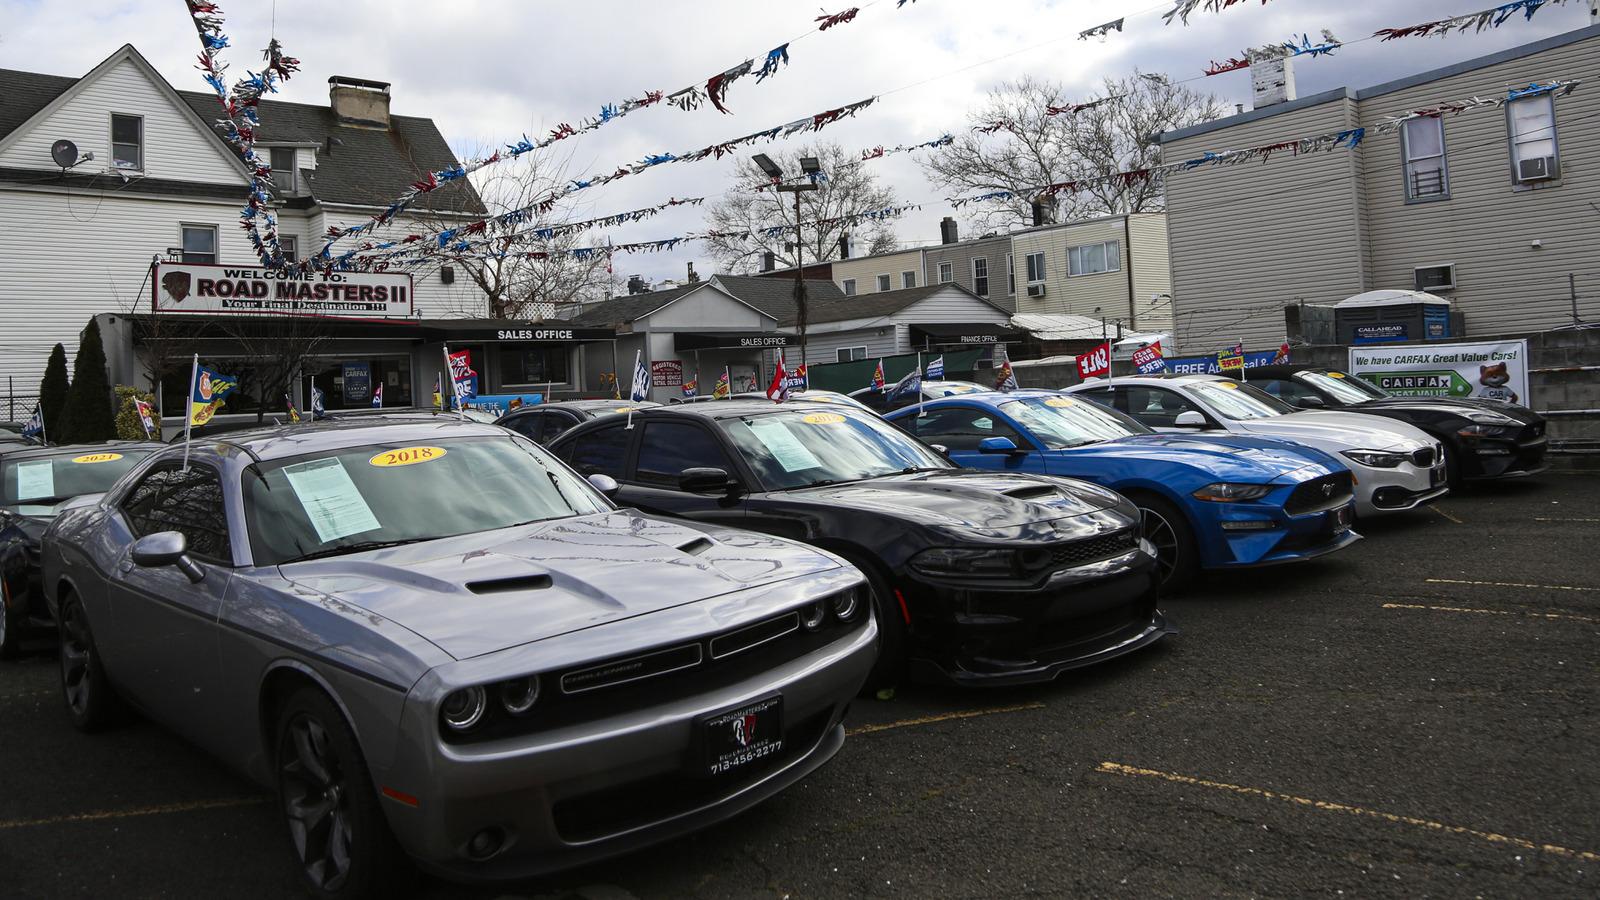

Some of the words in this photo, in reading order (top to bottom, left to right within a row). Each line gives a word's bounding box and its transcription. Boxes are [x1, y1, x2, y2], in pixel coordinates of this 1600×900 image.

[223, 269, 315, 282] WELCOME
[321, 270, 348, 283] TO:
[197, 278, 270, 299] ROAD
[276, 281, 389, 303] MASTERS
[391, 286, 406, 304] II
[225, 300, 258, 309] Your
[261, 300, 293, 309] Final
[299, 301, 367, 311] Destination
[498, 329, 533, 340] SALES
[535, 329, 573, 340] OFFICE
[960, 335, 981, 343] FINANCE
[981, 335, 998, 343] OFFICE
[741, 337, 763, 347] SALES
[763, 336, 787, 346] OFFICE
[1356, 356, 1369, 367] We
[1370, 355, 1392, 366] have
[1394, 354, 1430, 365] CARFAX
[1432, 353, 1459, 364] Great
[1461, 353, 1488, 363] Value
[1491, 350, 1517, 361] Cars!
[1174, 363, 1205, 375] FREE
[1382, 377, 1449, 388] CARFAX
[1489, 390, 1504, 398] CAR
[82, 454, 113, 463] 2021
[386, 448, 433, 466] 2018
